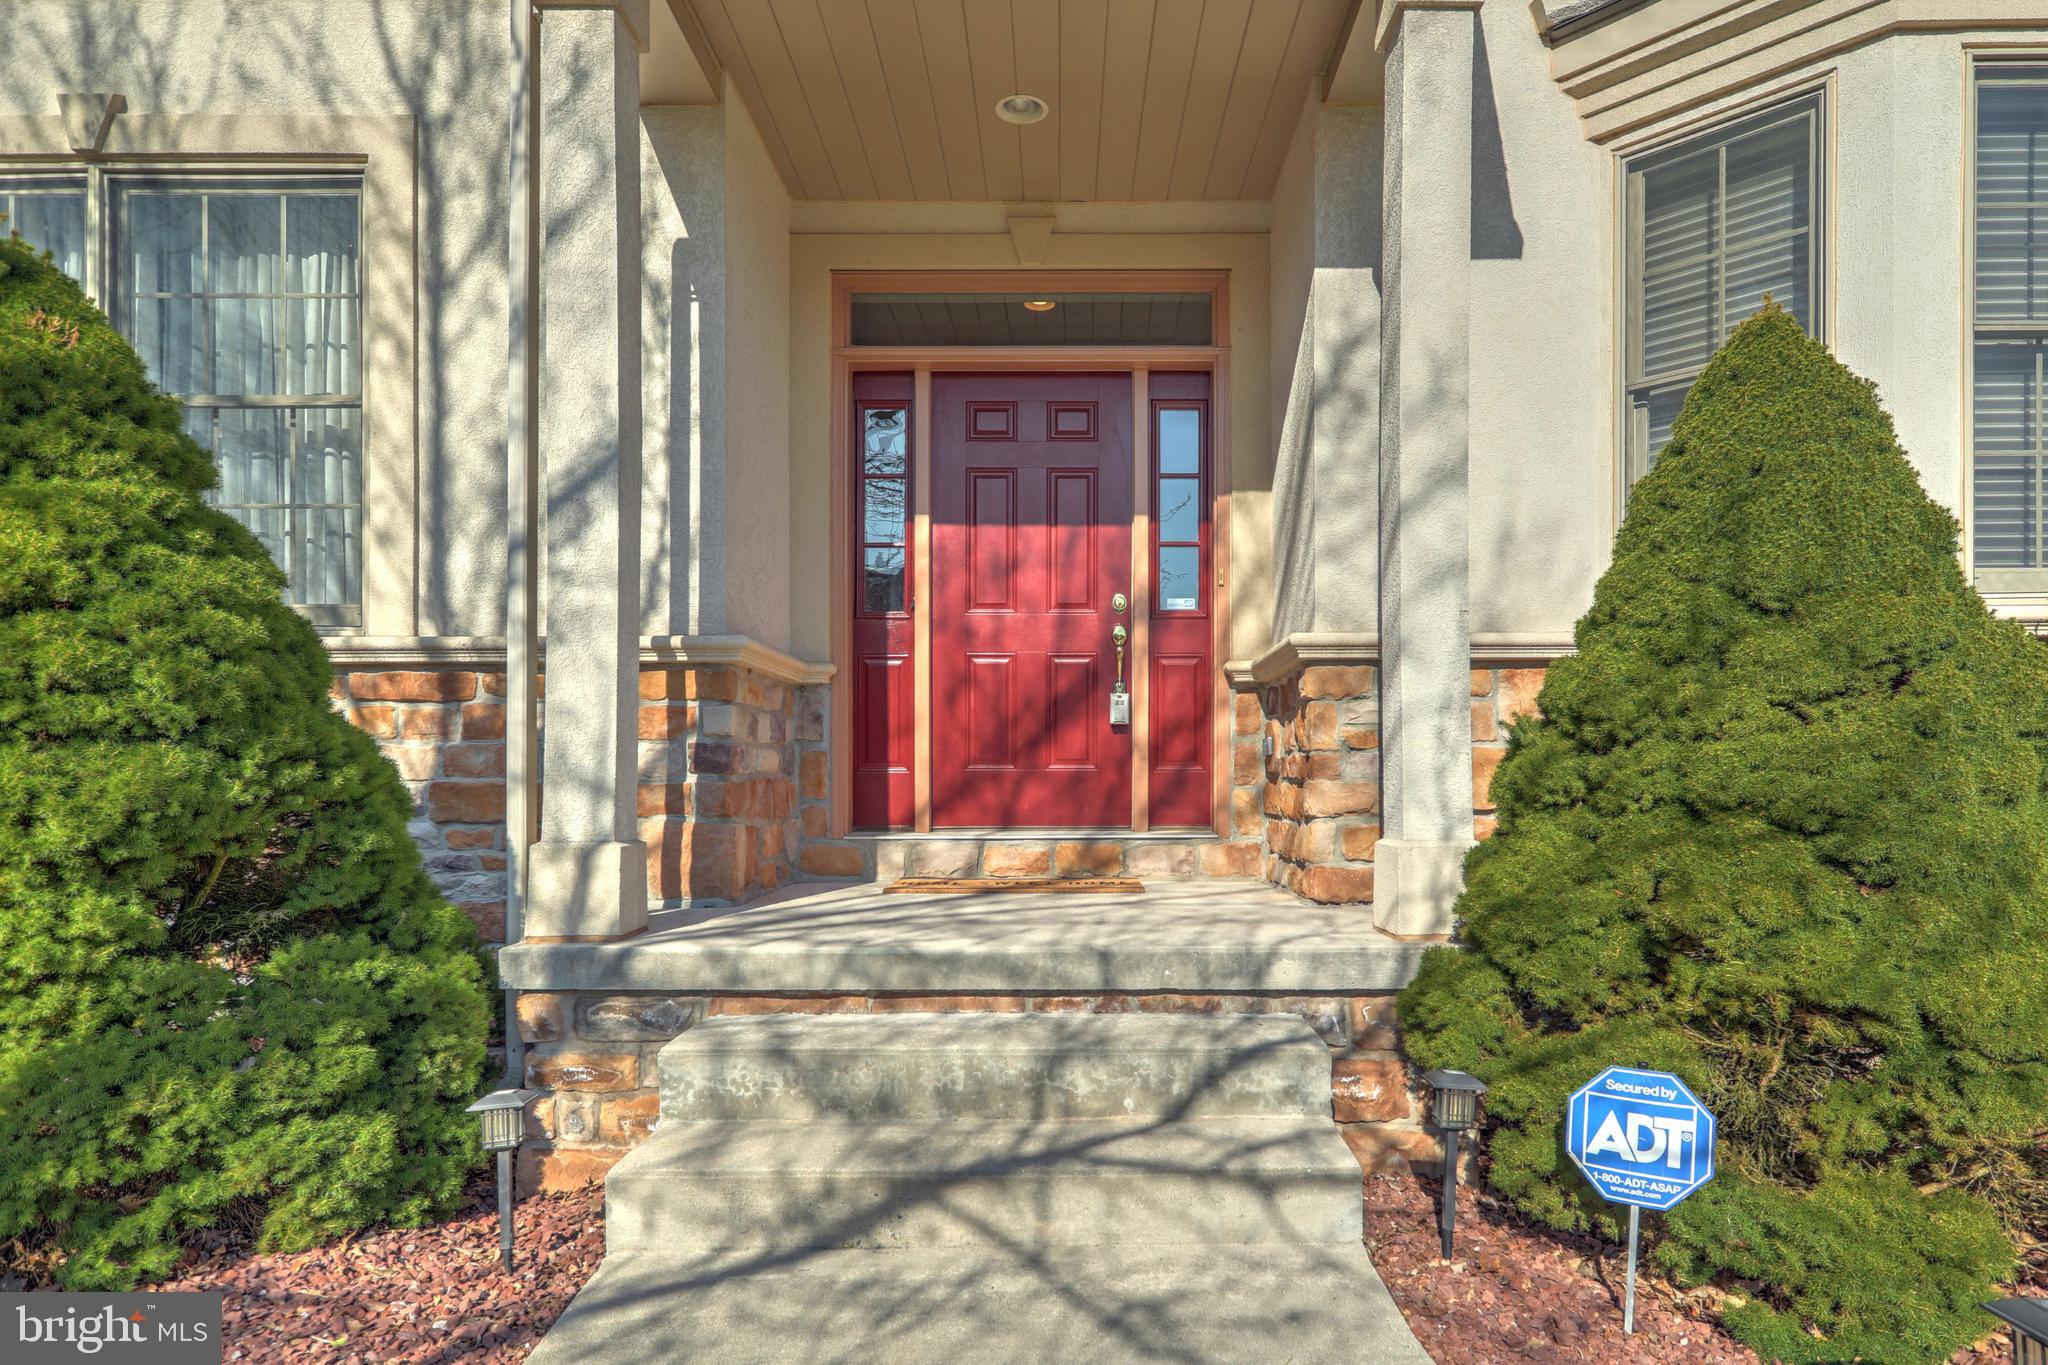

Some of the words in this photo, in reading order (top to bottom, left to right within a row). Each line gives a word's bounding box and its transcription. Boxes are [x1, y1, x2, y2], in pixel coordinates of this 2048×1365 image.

[1605, 1079, 1659, 1098] Secured
[1661, 1086, 1678, 1101] by
[1586, 1109, 1695, 1169] ADT
[1593, 1171, 1682, 1195] 1-800-ADT-ASAP
[1610, 1184, 1662, 1200] www.adt.com
